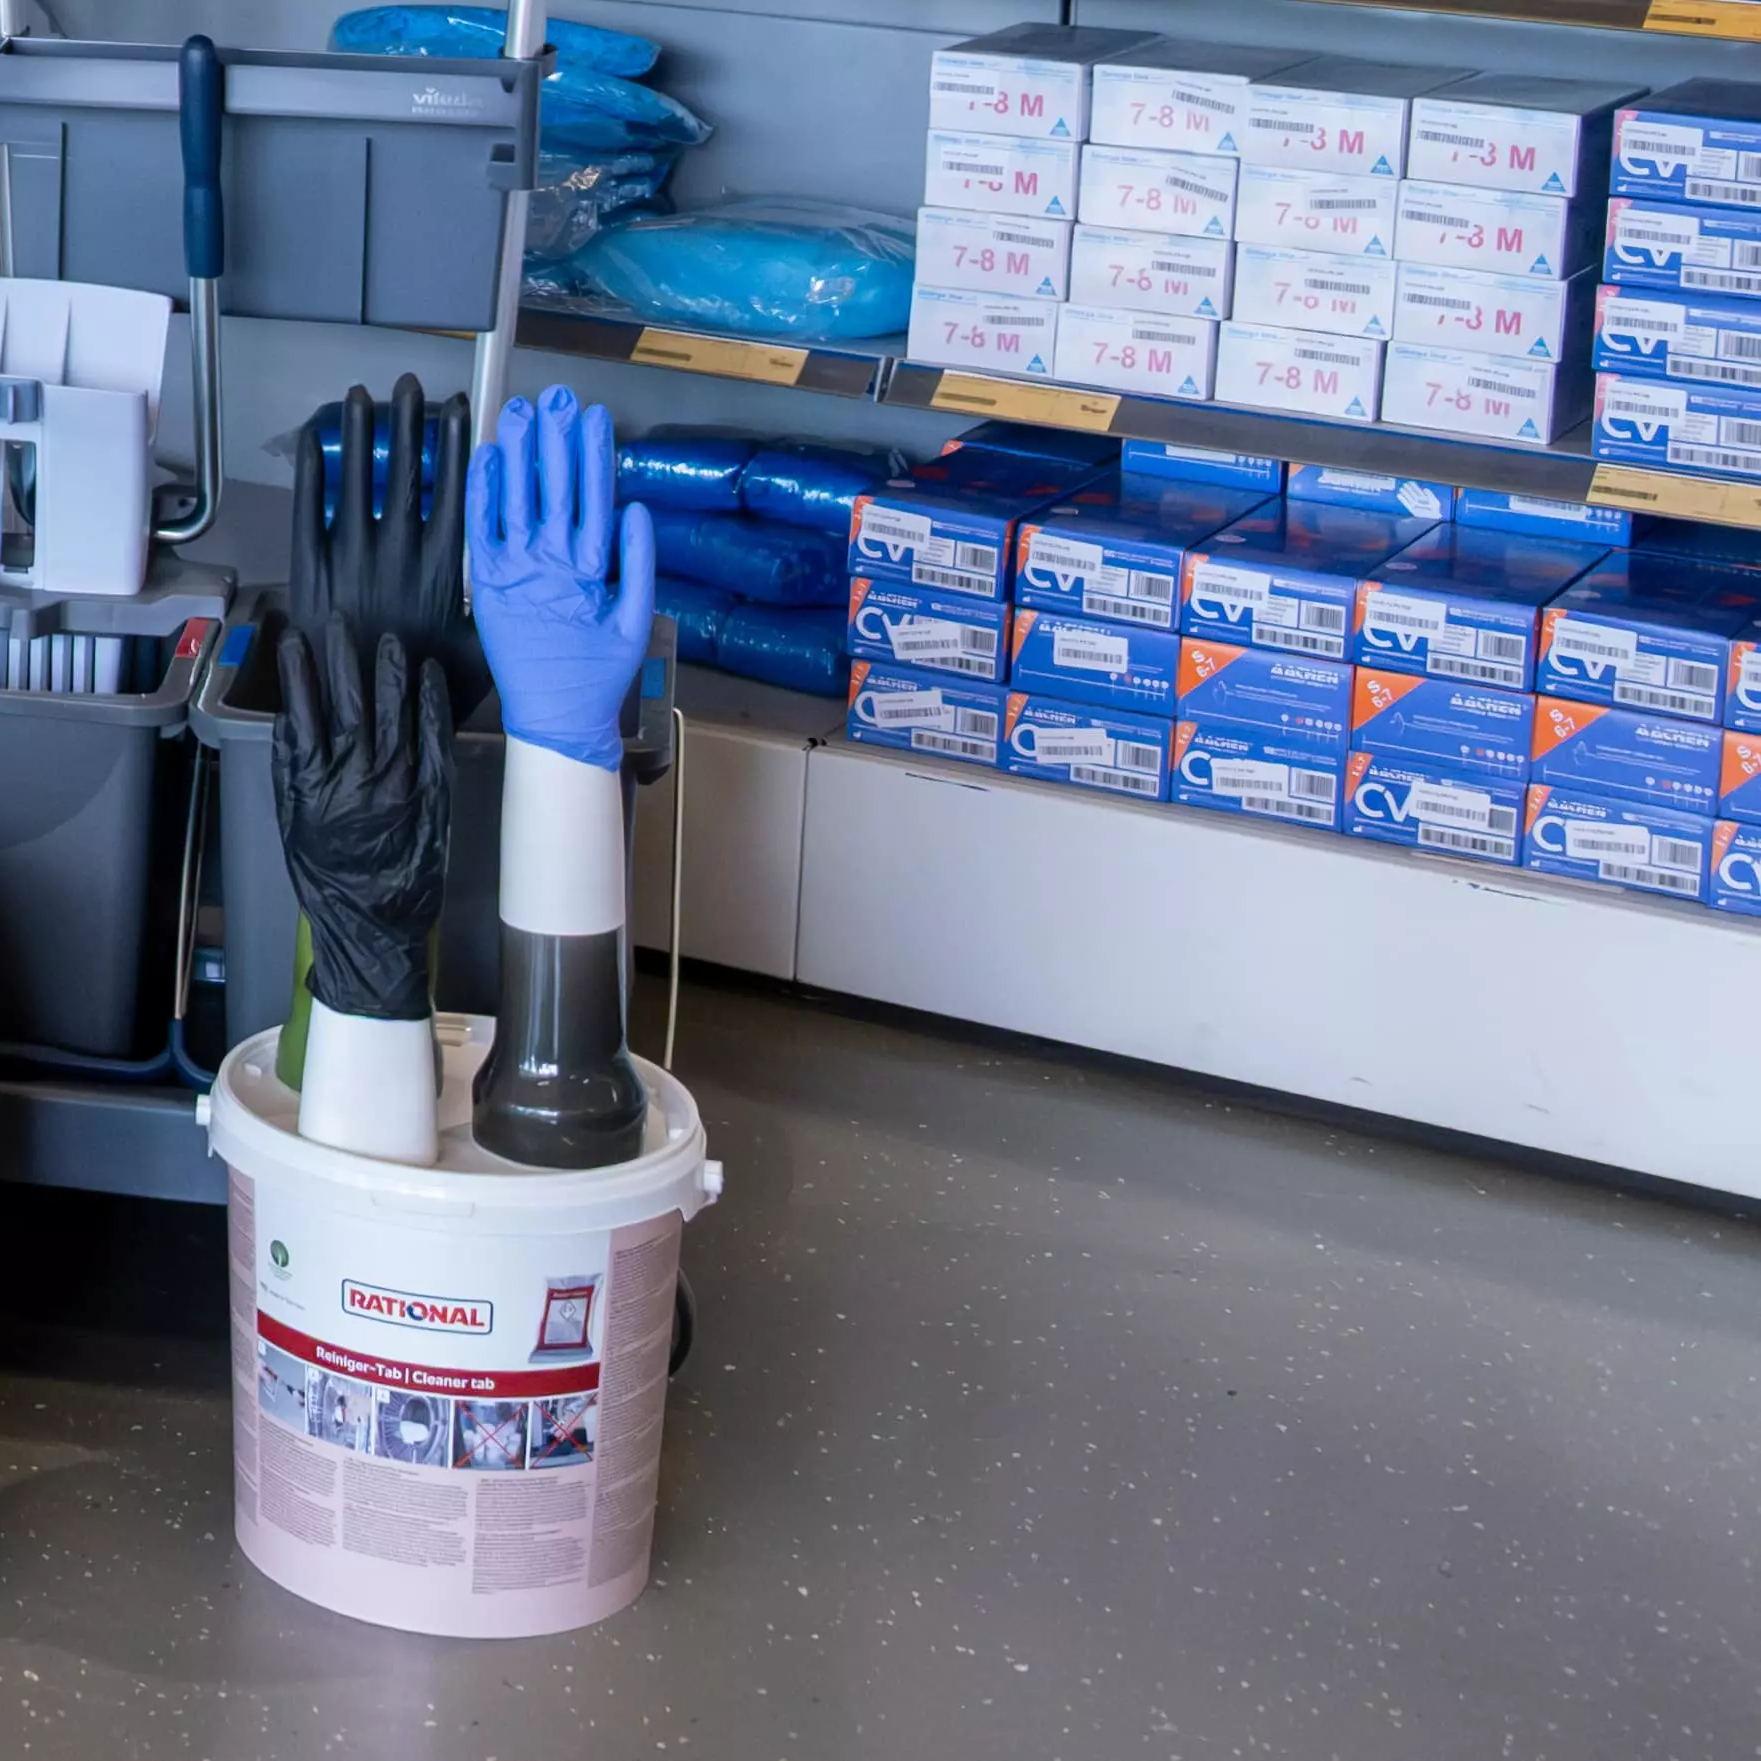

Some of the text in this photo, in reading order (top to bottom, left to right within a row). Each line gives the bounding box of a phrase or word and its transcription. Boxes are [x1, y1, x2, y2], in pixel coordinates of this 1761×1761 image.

[968, 91, 1044, 117] -8 M
[1130, 103, 1174, 129] 7-8
[1338, 129, 1364, 154] M
[1509, 145, 1536, 171] M
[1015, 171, 1038, 196] M
[1117, 186, 1162, 211] 7-8
[1497, 228, 1523, 253] M
[952, 245, 1030, 275] 7-8 M
[1495, 310, 1522, 335] M
[996, 333, 1021, 353] M
[1093, 342, 1172, 374] 7-8 M
[1256, 362, 1339, 394] 7-8 M
[1355, 783, 1413, 822] CV
[349, 1287, 485, 1327] RATIONAL
[316, 1346, 495, 1391] Reiniger-Tab Cleaner tab
